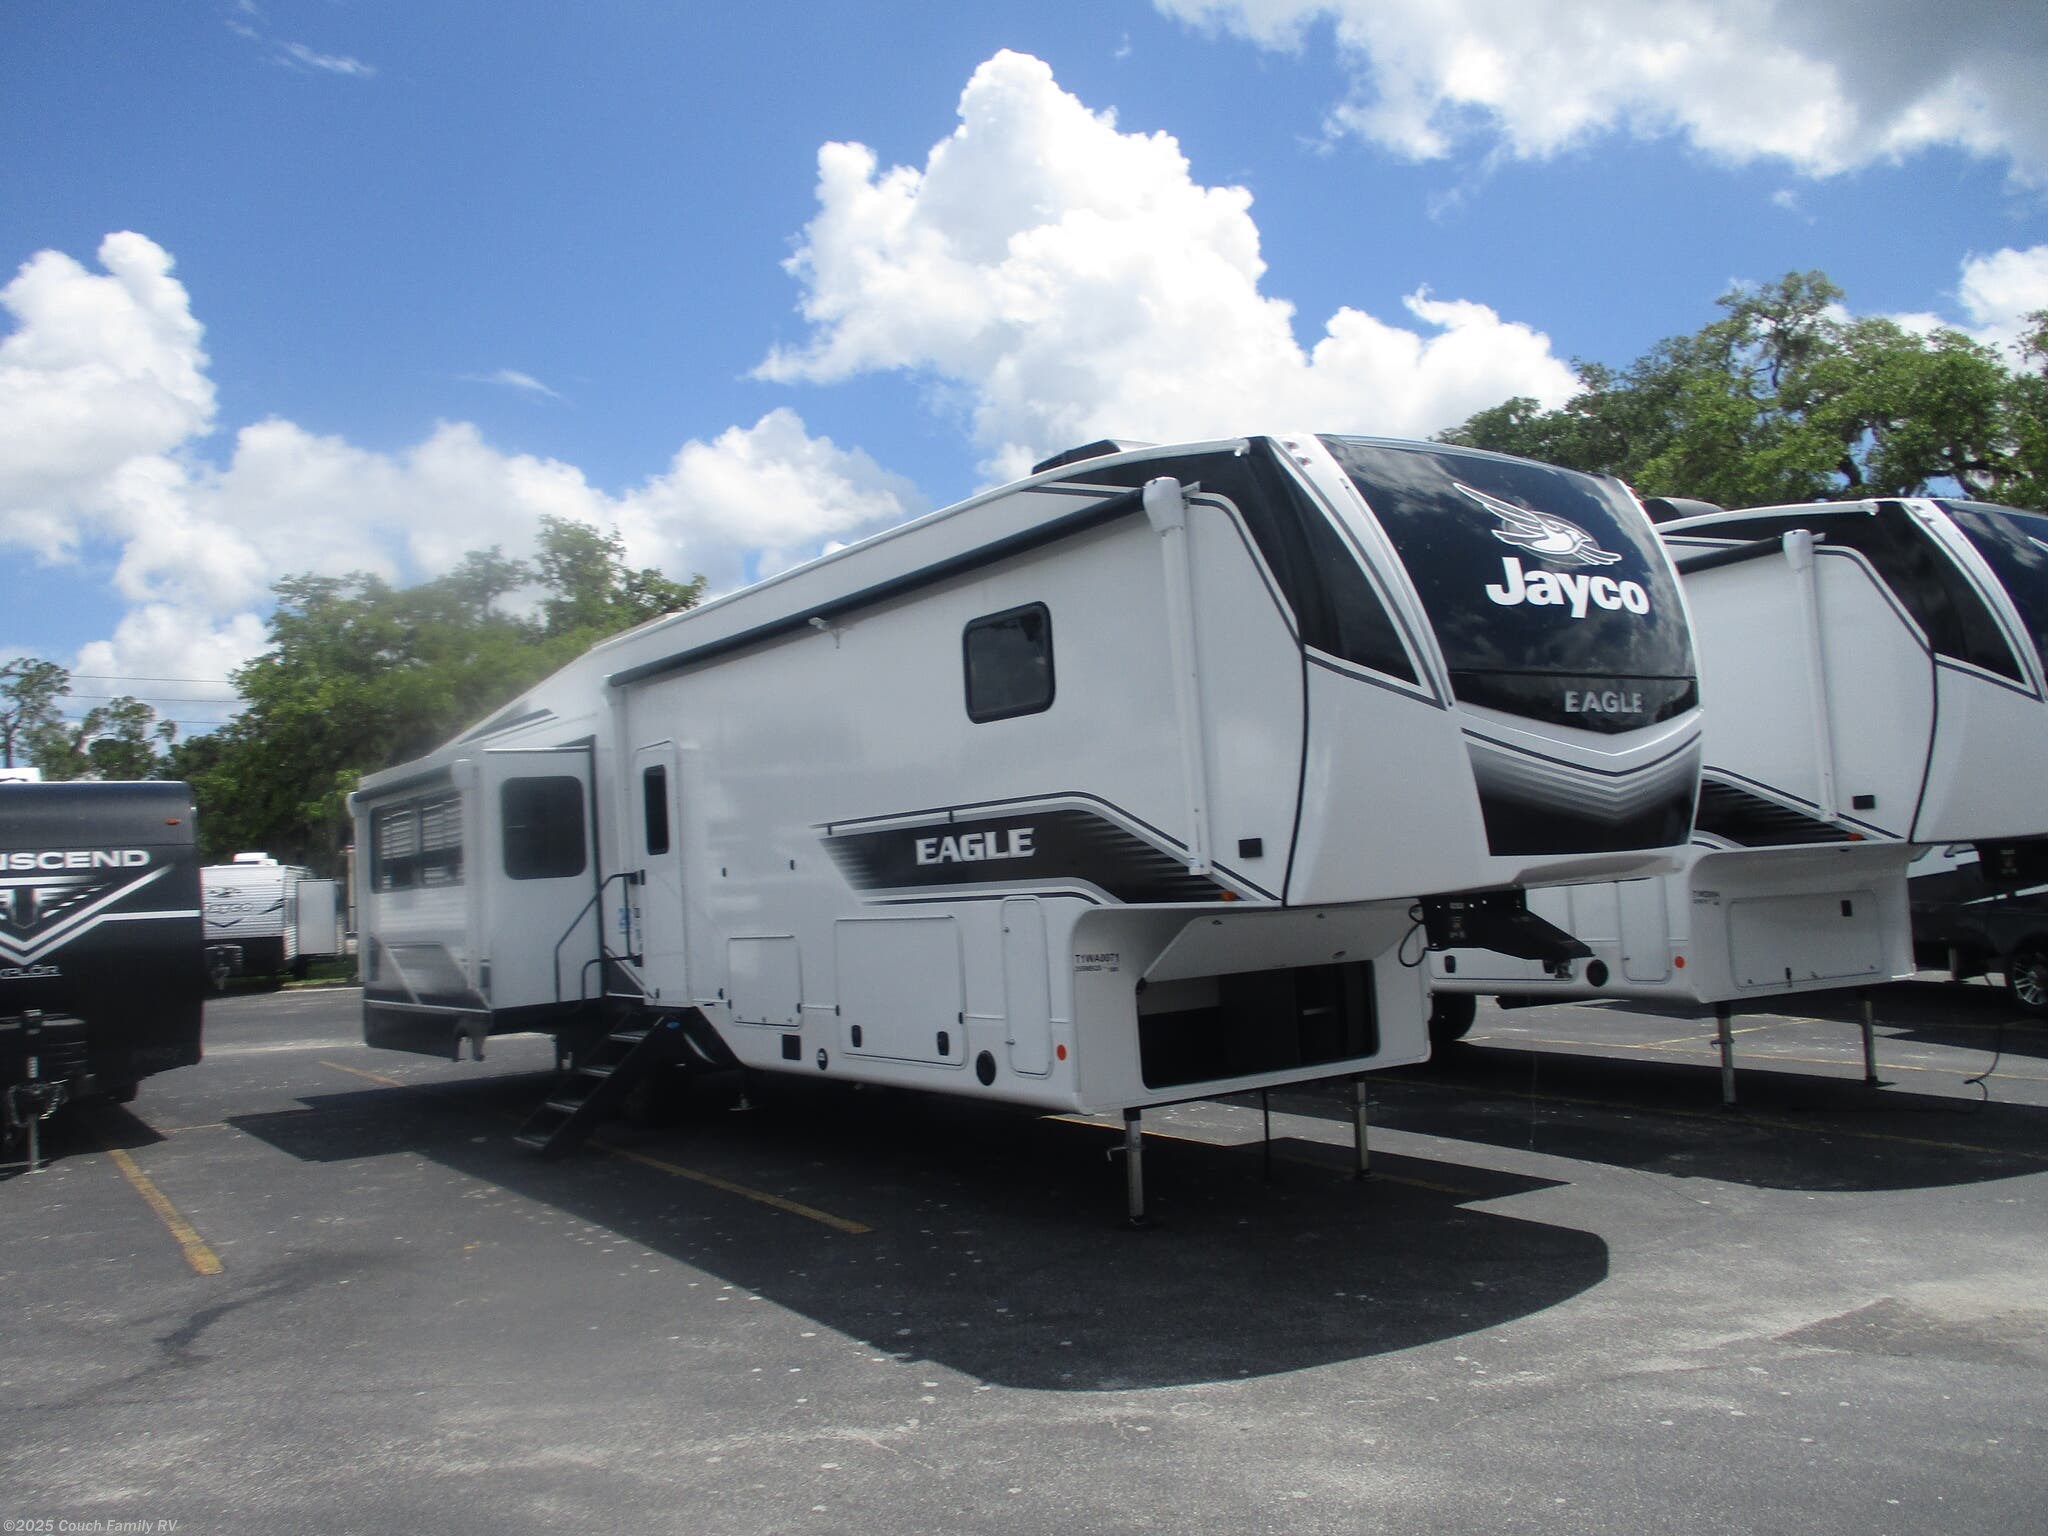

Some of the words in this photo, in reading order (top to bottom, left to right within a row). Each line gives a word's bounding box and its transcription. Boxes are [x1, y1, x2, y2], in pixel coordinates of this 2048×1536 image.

[1486, 556, 1649, 619] Jayco
[1564, 690, 1644, 714] EAGLE
[915, 827, 1036, 866] EAGLE
